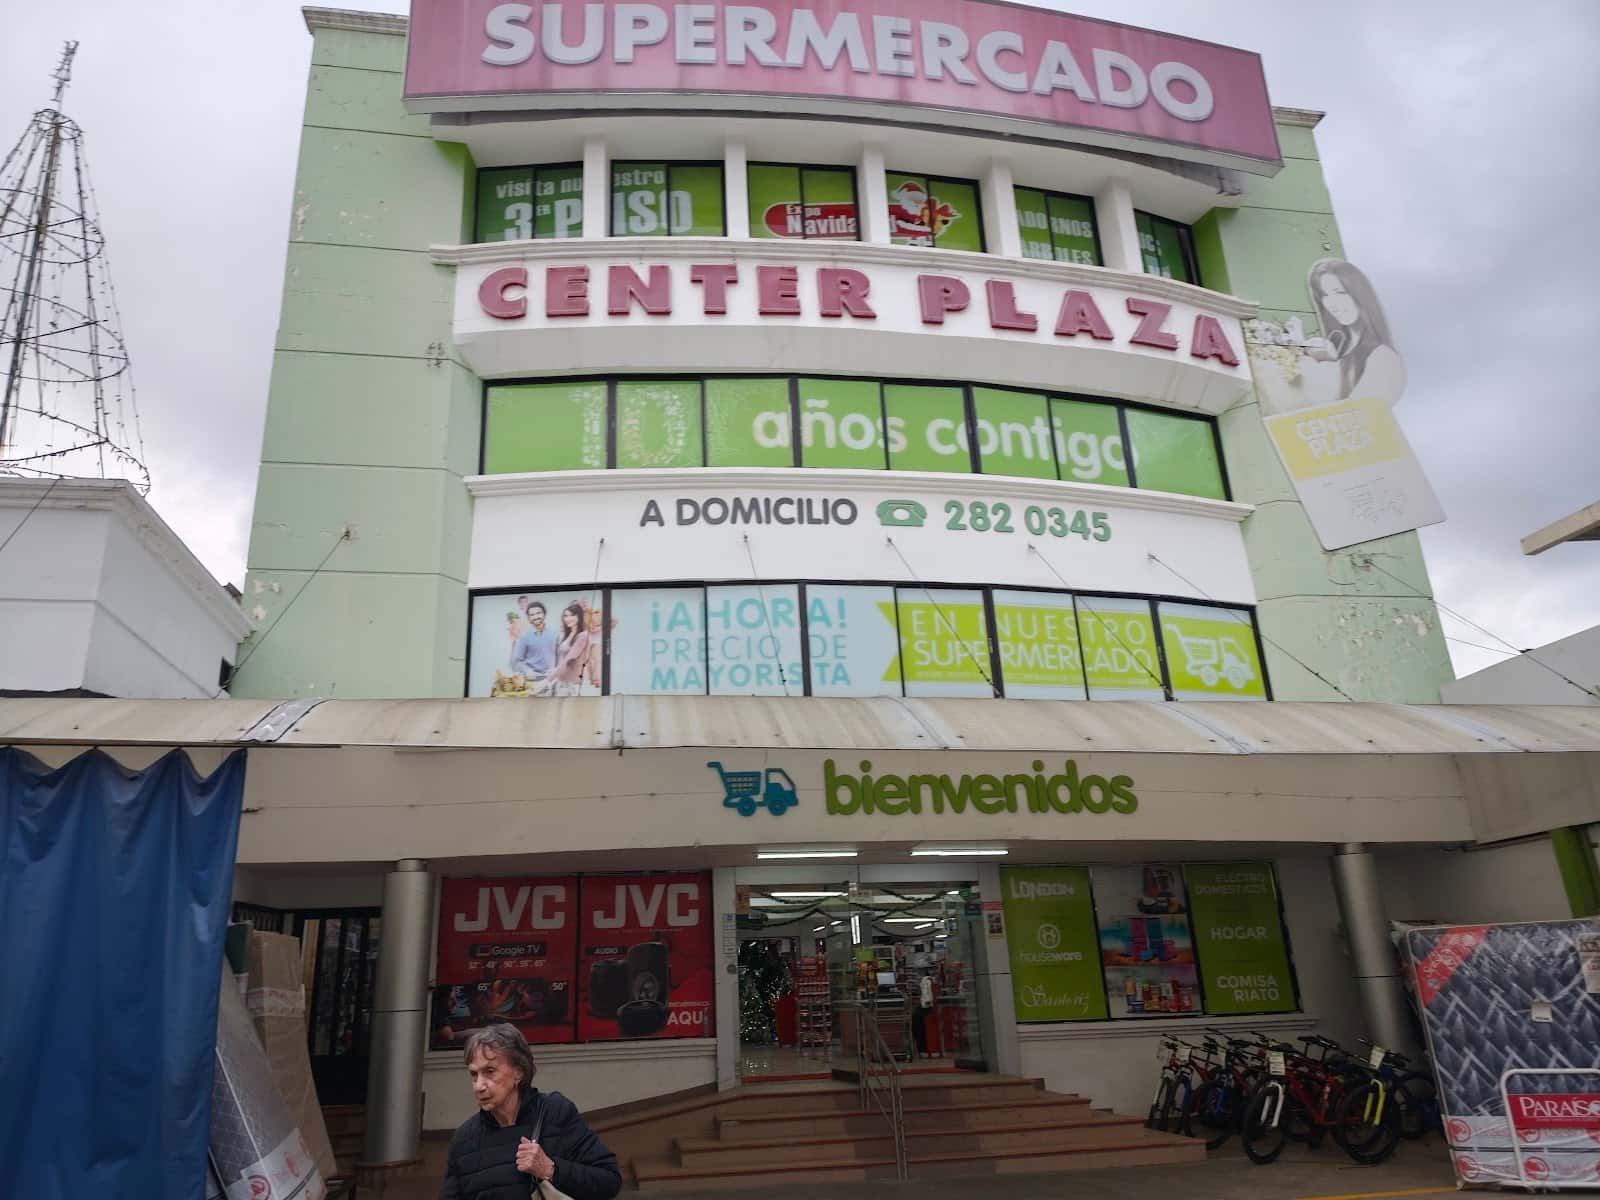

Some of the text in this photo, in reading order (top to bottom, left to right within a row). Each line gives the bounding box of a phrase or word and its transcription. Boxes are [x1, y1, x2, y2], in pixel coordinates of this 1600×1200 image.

[480, 2, 1215, 123] SUPERMERCADO
[495, 178, 556, 200] visita
[478, 264, 1240, 367] CENTER PLAZA
[752, 398, 908, 454] años
[926, 414, 1138, 480] contigo
[639, 497, 1113, 542] A DOMICILIO 282 0345
[912, 609, 1148, 645] EN NUESTRO
[650, 633, 848, 664] PRECIO DE
[914, 639, 1153, 674] SUPERMERCADO
[650, 662, 851, 691] MAYORISTA
[823, 758, 1139, 816] bienvenidos
[454, 887, 566, 931] JVC
[593, 884, 698, 928] JVC
[492, 944, 541, 956] Google TV
[1210, 926, 1268, 940] HOGAR
[1216, 975, 1279, 989] COMISA
[1232, 988, 1280, 1002] RIATO
